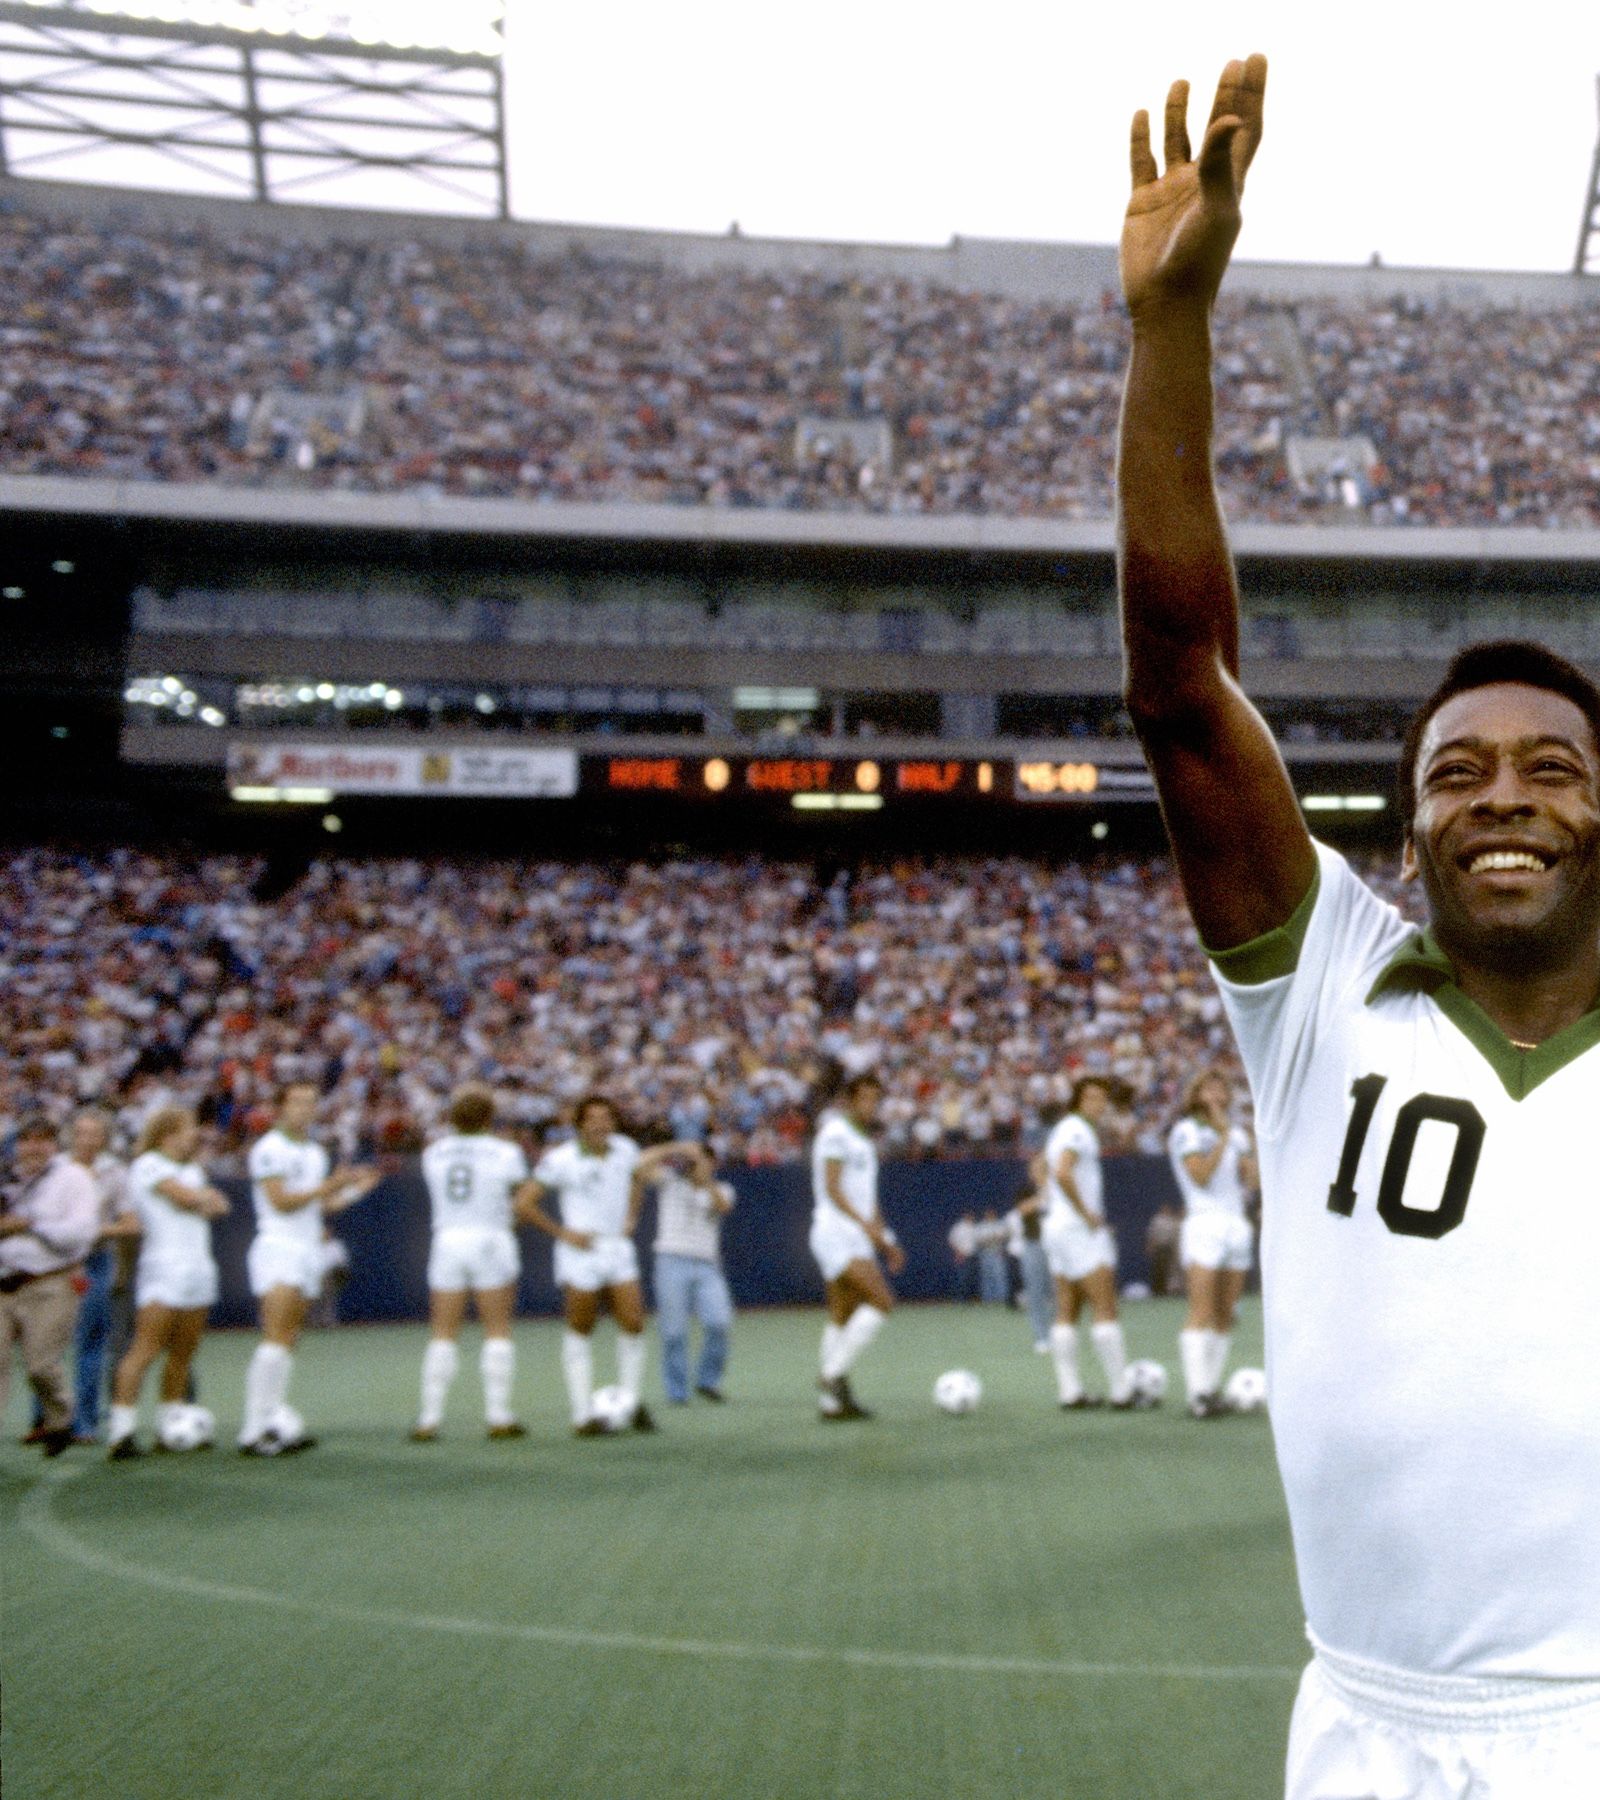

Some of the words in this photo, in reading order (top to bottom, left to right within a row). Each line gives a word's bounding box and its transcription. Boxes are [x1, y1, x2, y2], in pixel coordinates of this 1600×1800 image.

[609, 759, 679, 789] HOME
[704, 758, 730, 791] 0
[1326, 1072, 1488, 1240] 10
[445, 1163, 474, 1204] 8
